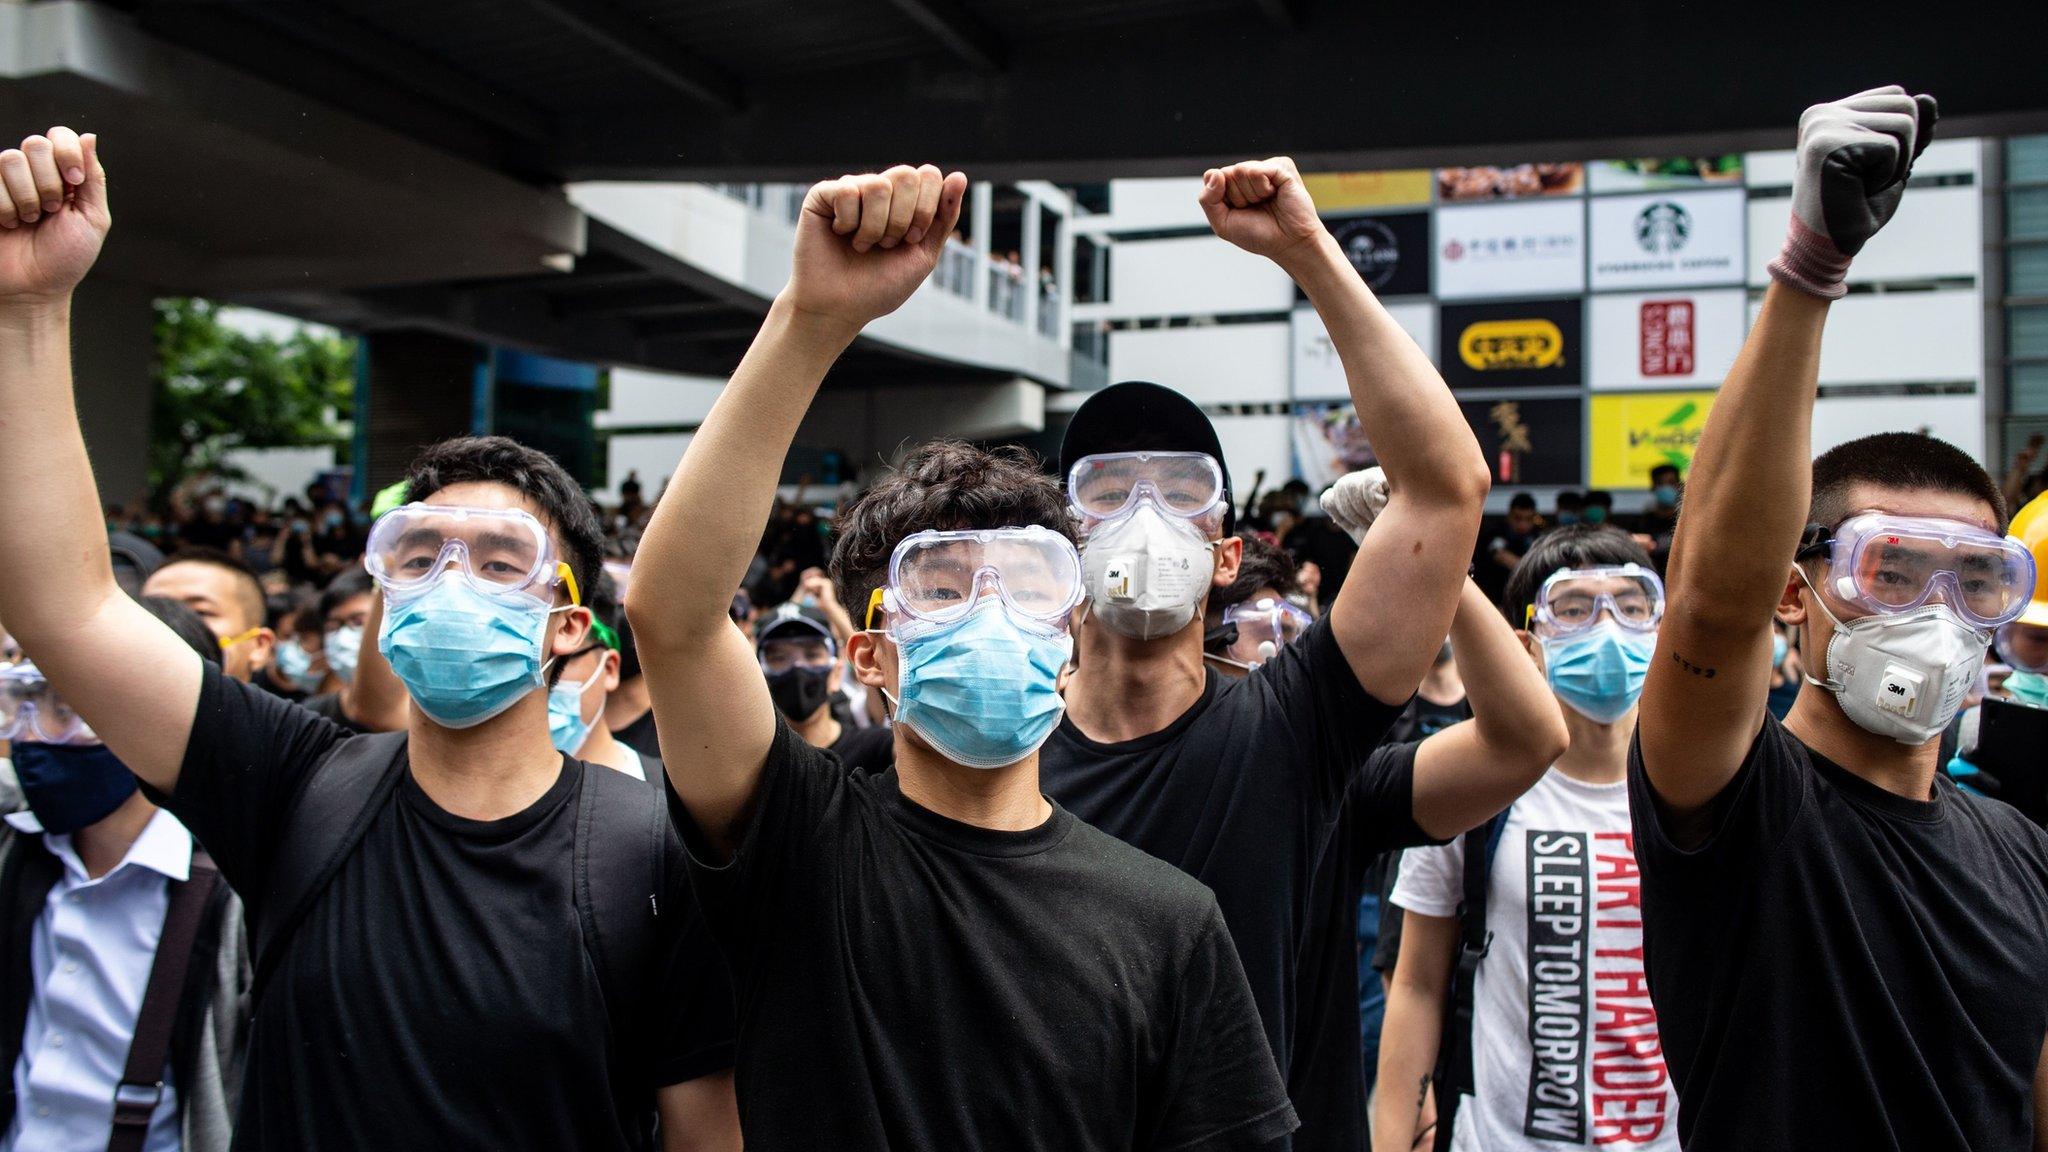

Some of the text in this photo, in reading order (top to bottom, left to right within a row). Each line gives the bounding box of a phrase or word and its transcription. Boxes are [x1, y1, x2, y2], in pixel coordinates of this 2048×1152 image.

[1886, 536, 1899, 544] 3M
[1108, 570, 1120, 578] 3M
[1887, 683, 1906, 696] 3M
[1531, 833, 1583, 1139] SLEEP TOMORROW
[1592, 971, 1668, 1145] HARDER
